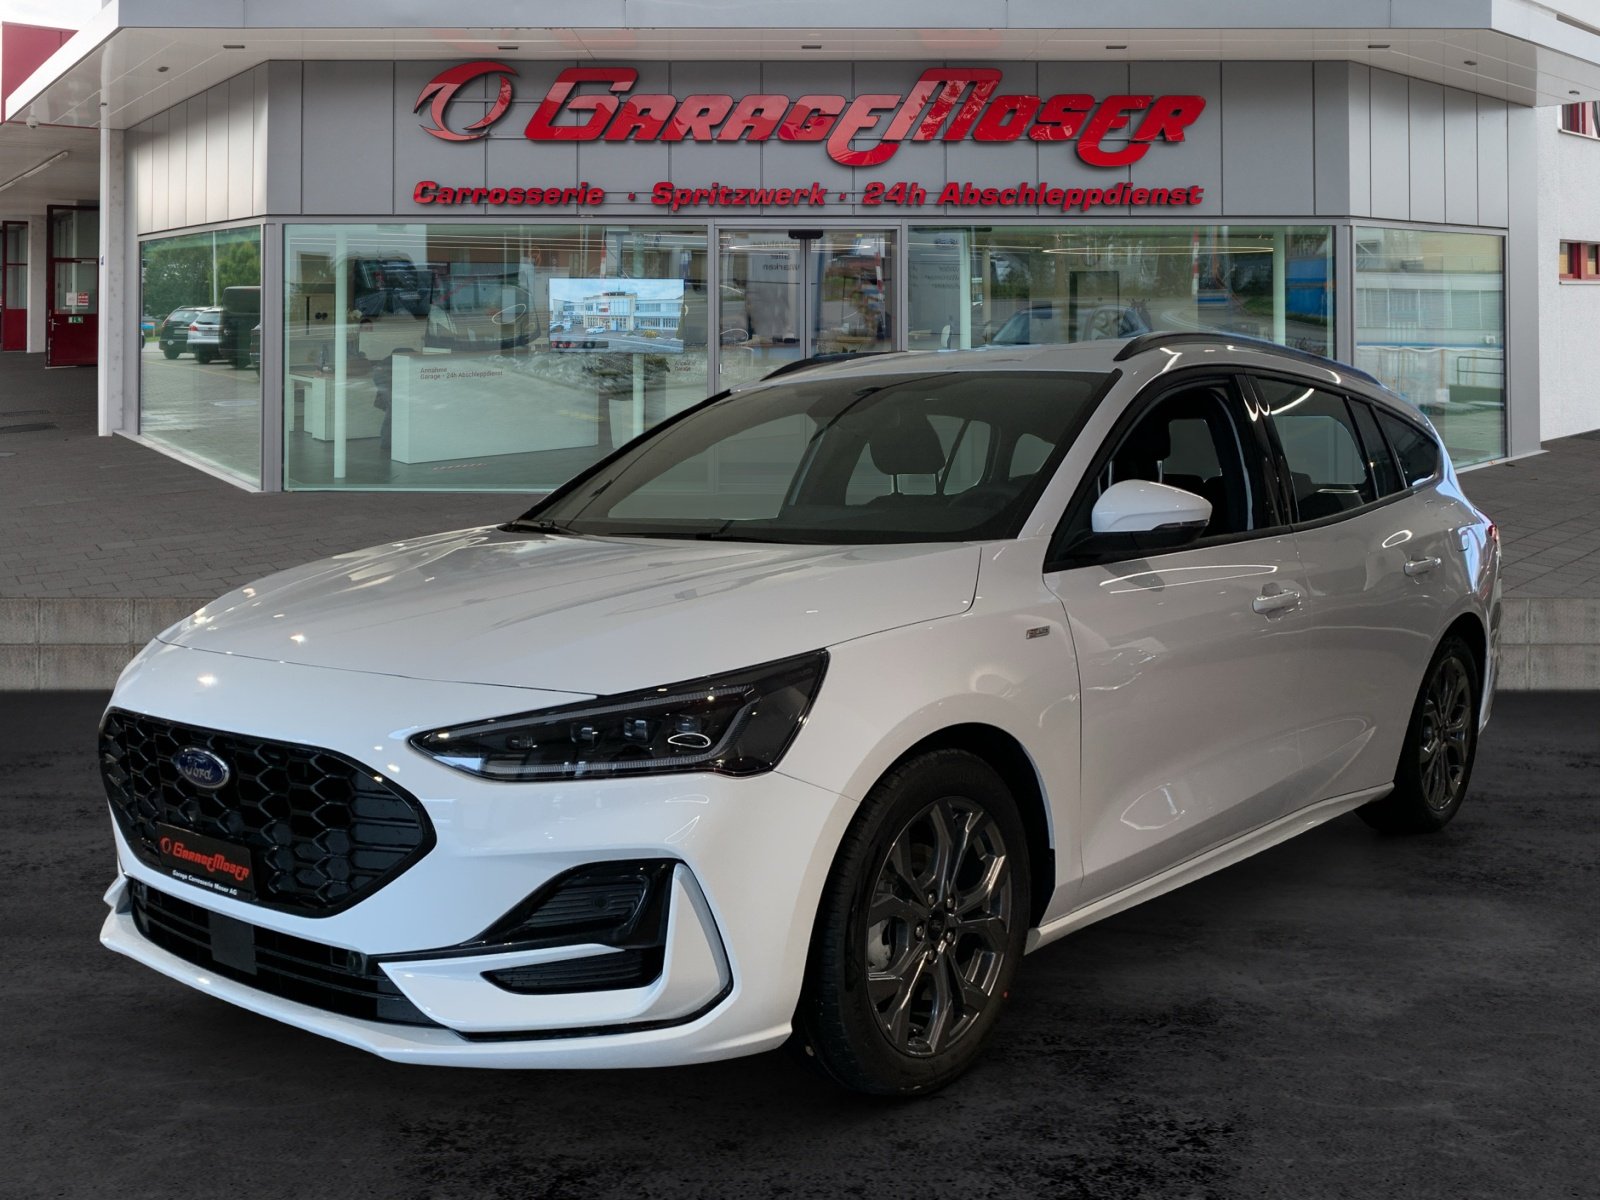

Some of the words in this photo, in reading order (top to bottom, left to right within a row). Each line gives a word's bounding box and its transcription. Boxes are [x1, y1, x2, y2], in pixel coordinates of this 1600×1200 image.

[412, 180, 605, 207] Carrosserie
[651, 181, 827, 211] Spritzwerk
[862, 181, 927, 207] 24h
[936, 181, 1205, 213] Abschleppdienst
